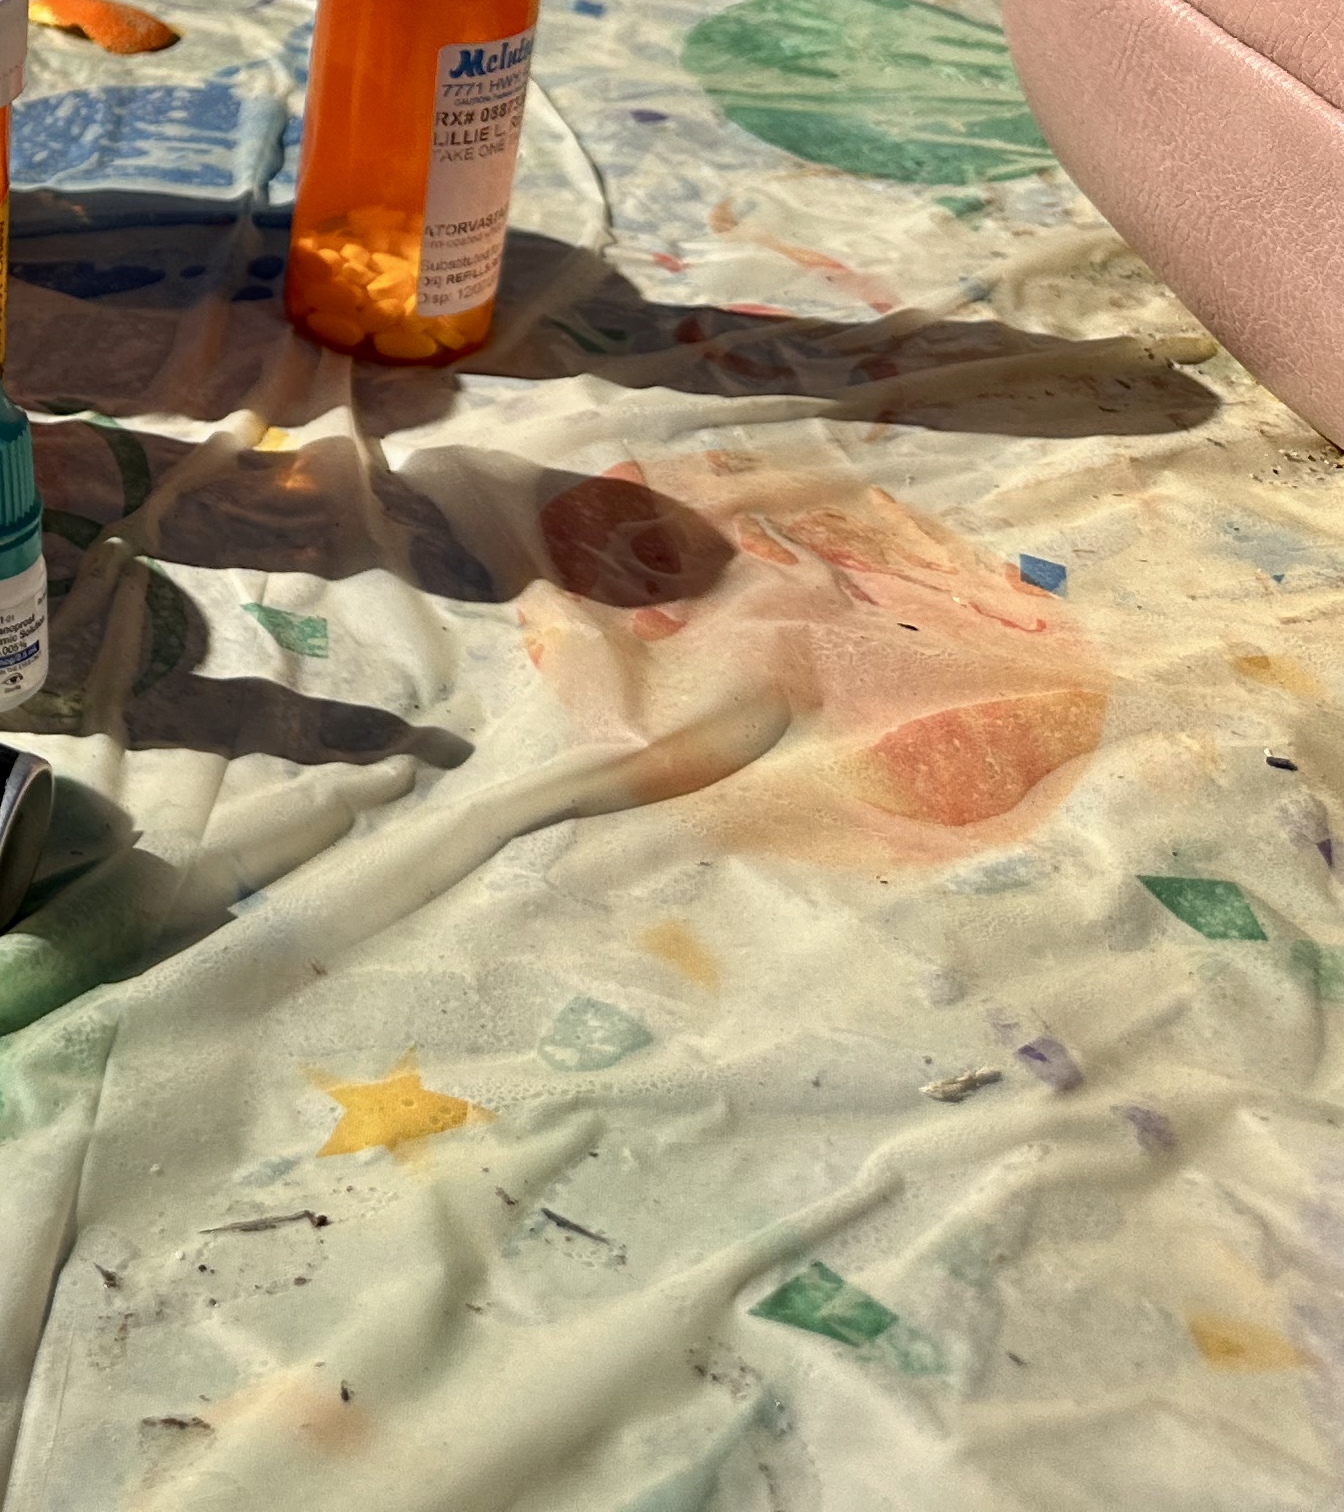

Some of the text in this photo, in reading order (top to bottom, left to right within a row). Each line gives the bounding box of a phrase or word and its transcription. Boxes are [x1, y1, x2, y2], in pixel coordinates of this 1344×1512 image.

[443, 83, 483, 97] 7771
[436, 111, 475, 127] RX#
[433, 126, 489, 147] LILLIE
[433, 141, 505, 162] TAKE ONE
